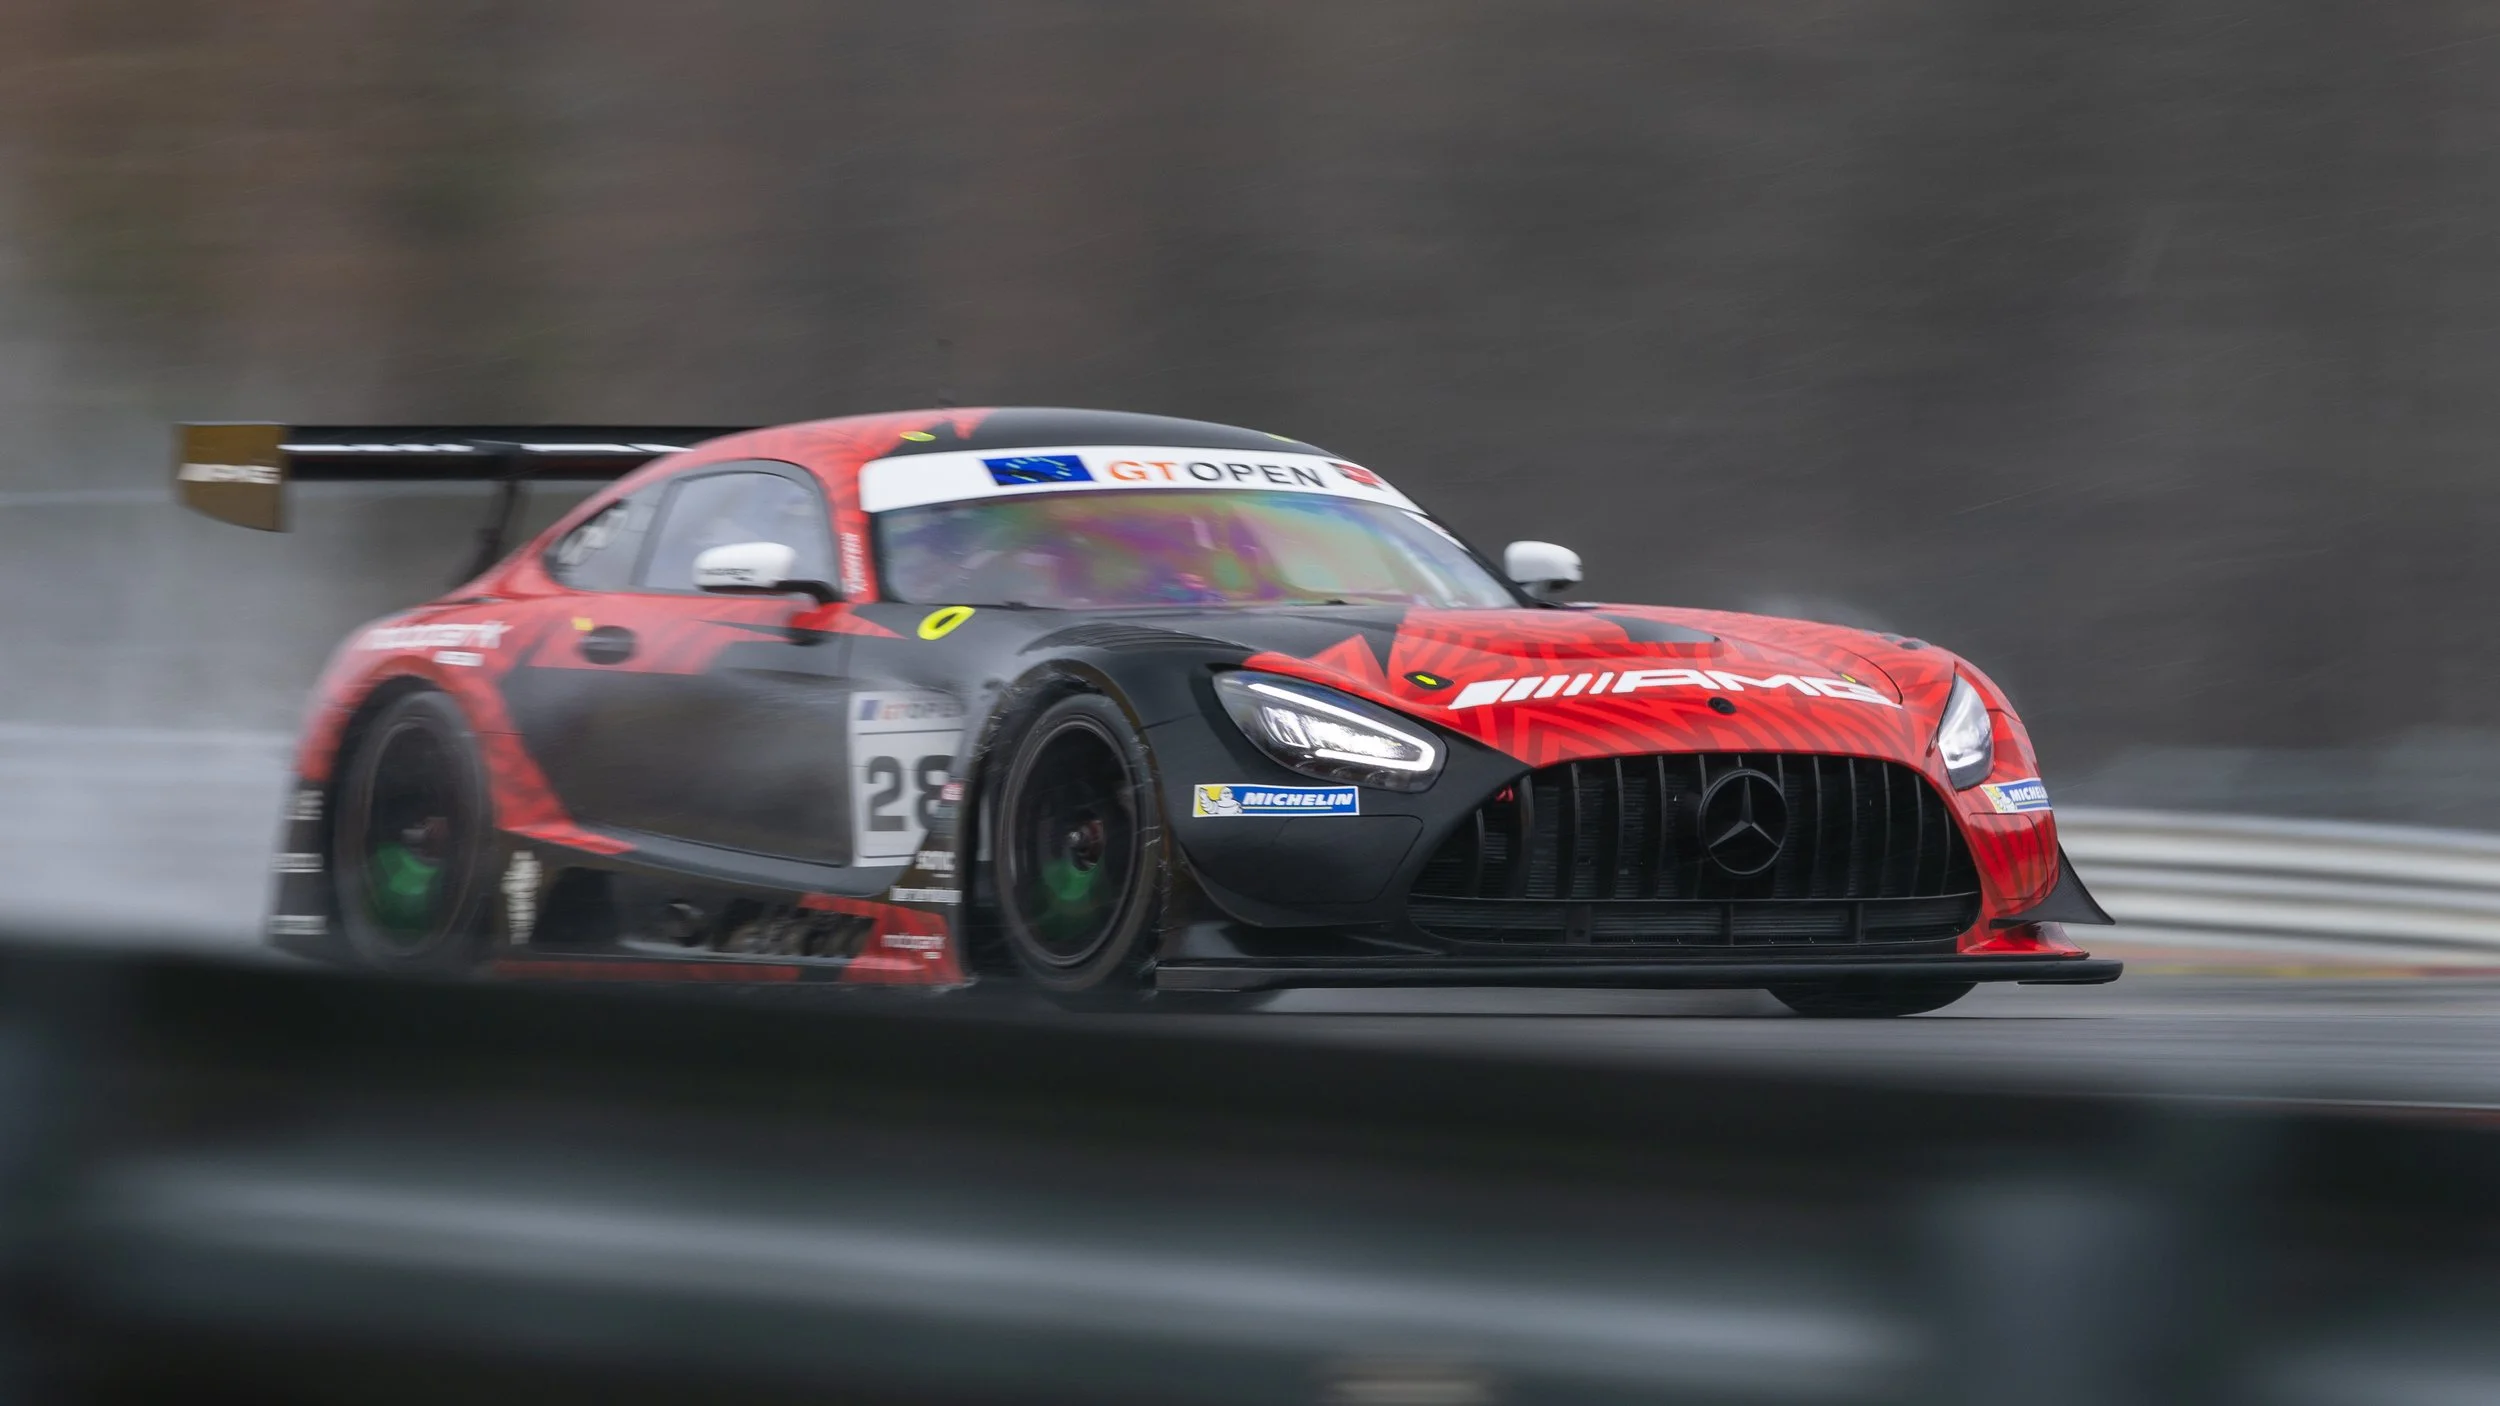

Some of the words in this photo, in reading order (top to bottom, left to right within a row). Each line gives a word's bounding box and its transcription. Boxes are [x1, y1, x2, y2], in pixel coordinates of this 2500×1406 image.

[1612, 669, 1903, 709] AMG
[866, 755, 957, 833] 28
[1242, 792, 1354, 806] MICHELIN
